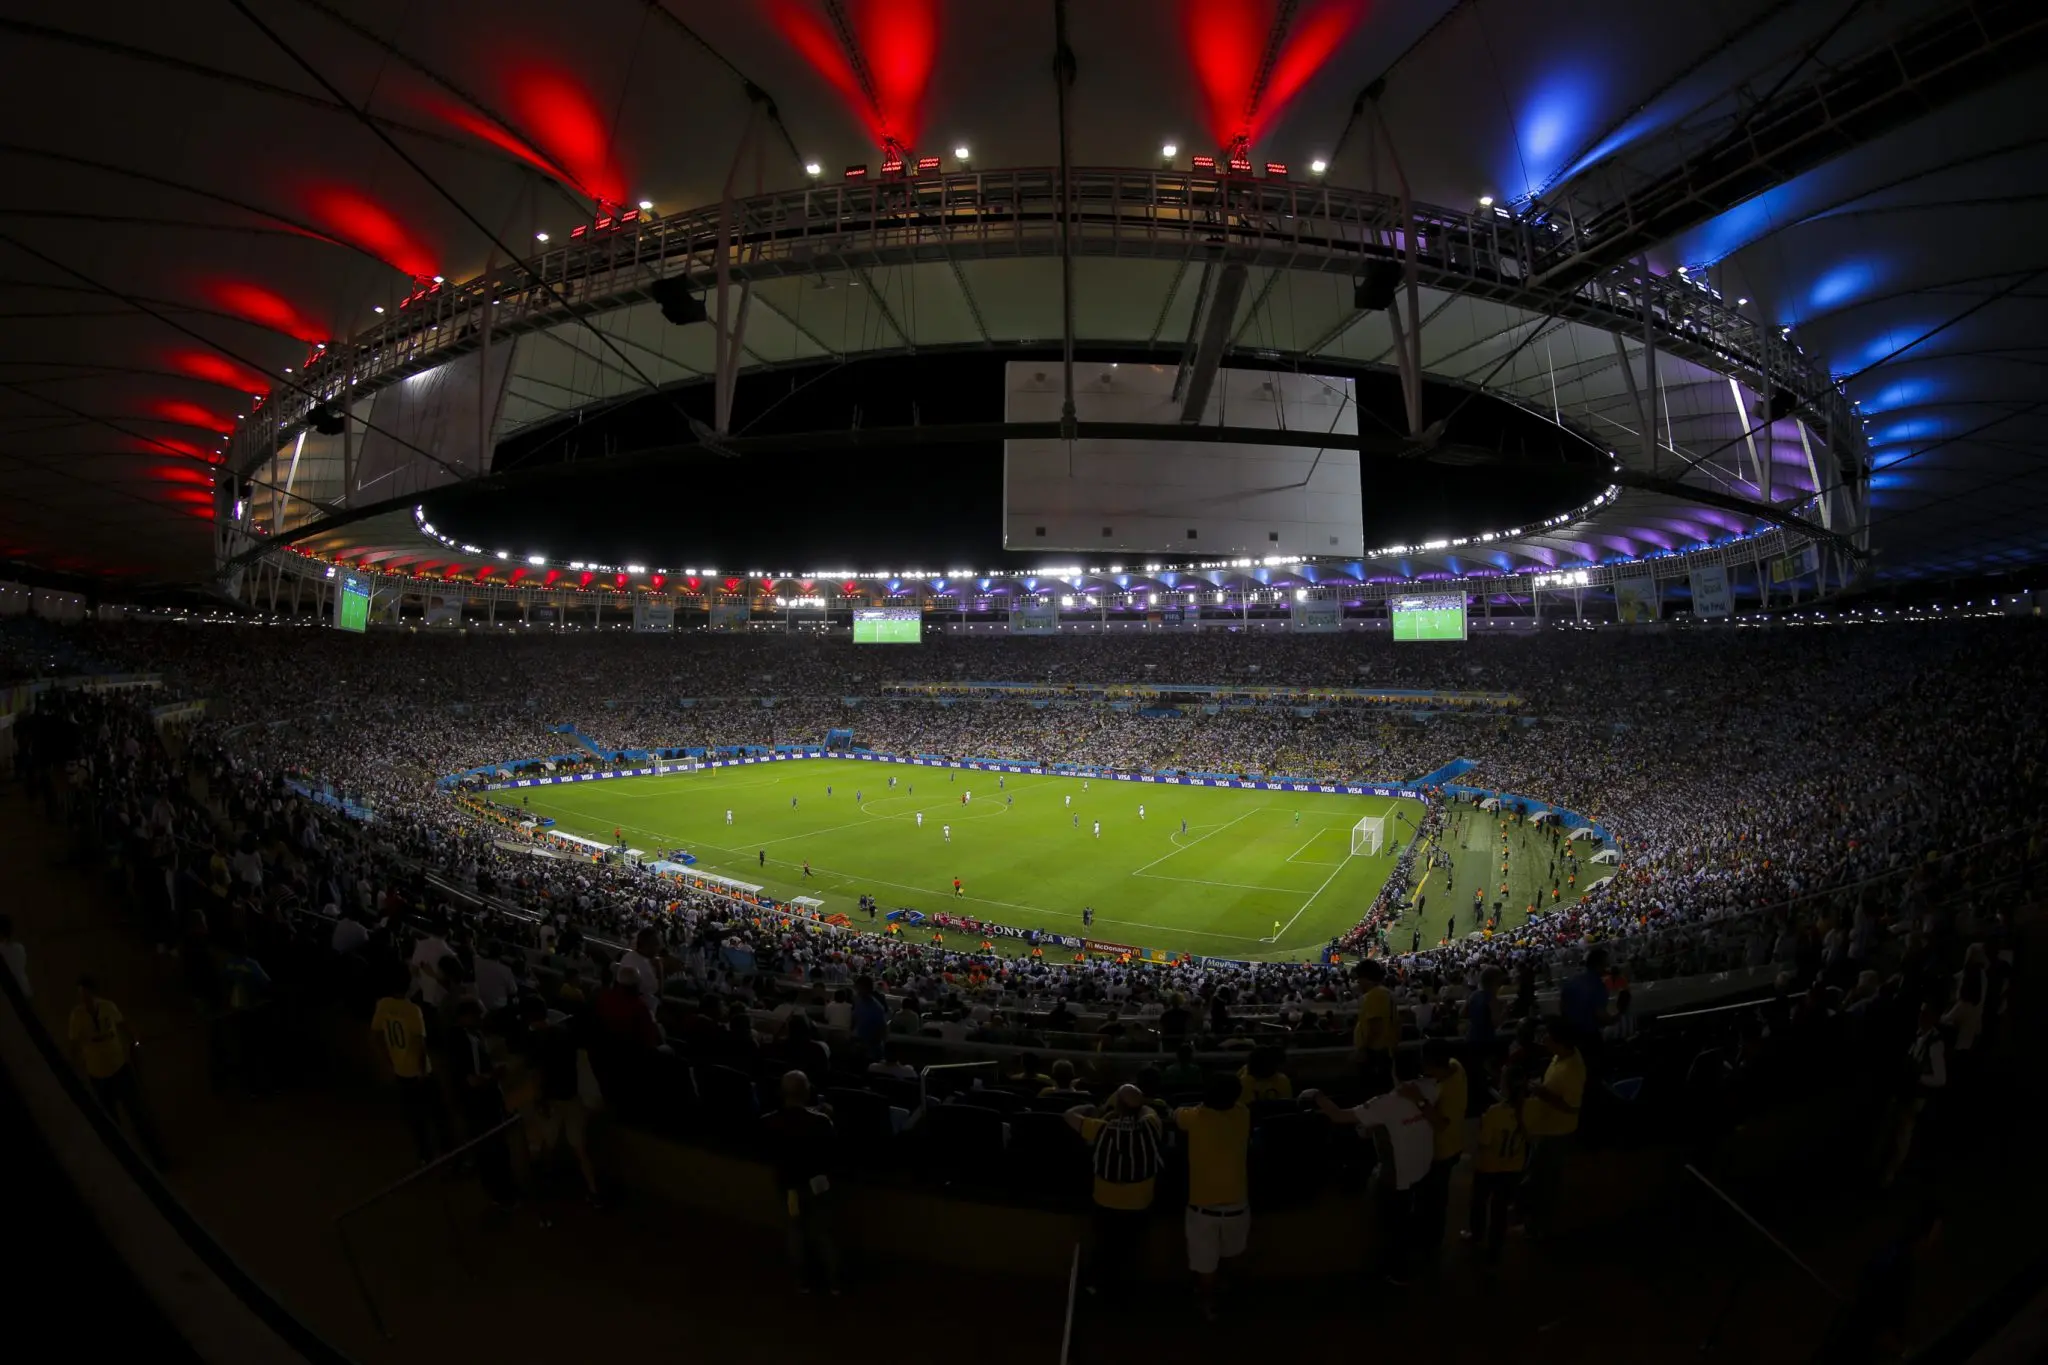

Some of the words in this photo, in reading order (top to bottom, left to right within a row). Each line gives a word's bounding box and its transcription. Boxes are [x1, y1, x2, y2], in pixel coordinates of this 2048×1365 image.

[517, 779, 531, 787] VISA
[560, 775, 573, 783] VISA
[581, 773, 594, 781] VISA
[1401, 790, 1416, 798] VISA
[983, 923, 1025, 938] SONY
[1094, 943, 1132, 954] McDonald's
[386, 1019, 406, 1049] 10
